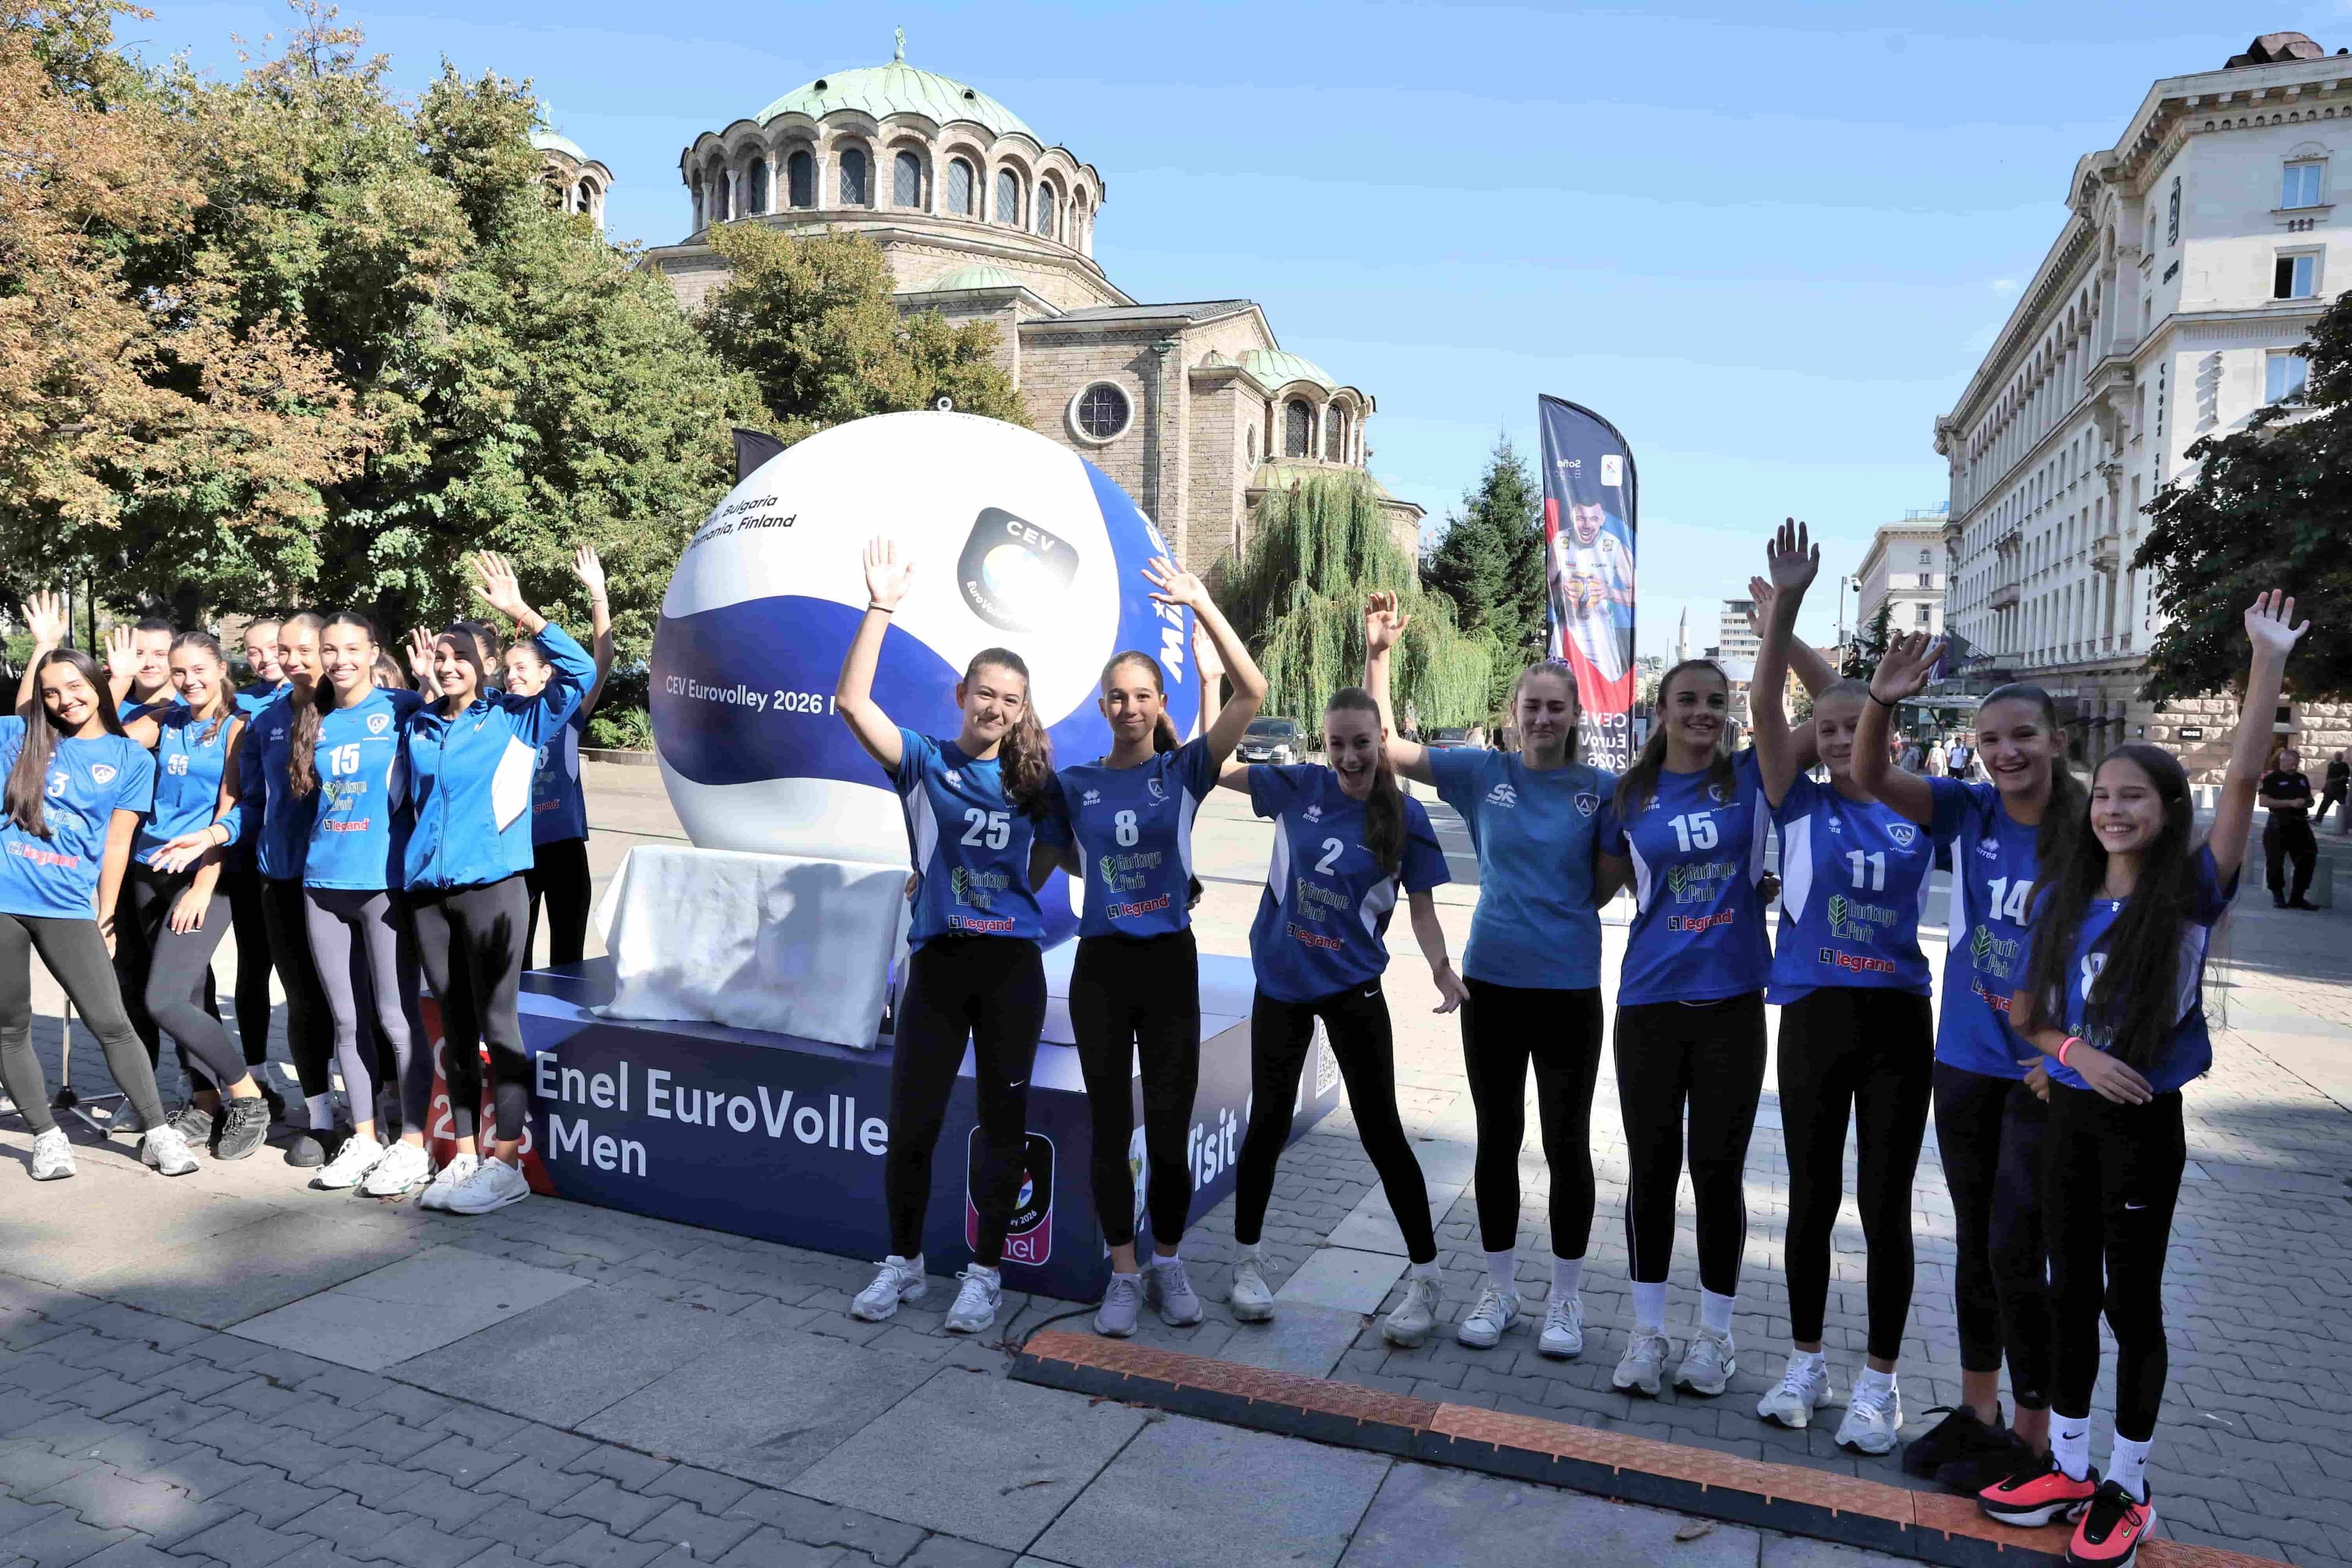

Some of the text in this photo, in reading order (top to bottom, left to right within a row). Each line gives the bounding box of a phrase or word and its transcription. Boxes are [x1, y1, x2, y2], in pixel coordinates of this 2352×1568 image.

[722, 494, 778, 518] Bulgaria
[737, 514, 797, 531] Finland
[1006, 520, 1055, 551] CEV
[666, 675, 687, 696] CEV
[688, 679, 768, 713] Eurovolley
[773, 690, 823, 715] 2026
[167, 753, 190, 776] 55
[329, 742, 361, 776] 15
[47, 771, 70, 797] 3
[960, 807, 1011, 850] 25
[1115, 809, 1139, 847] 8
[1667, 811, 1719, 853] 15
[1116, 851, 1162, 872] Garitage
[1314, 837, 1344, 876] 2
[1120, 872, 1145, 890] Park
[1686, 861, 1736, 881] Garitage
[1845, 850, 1886, 892] 11
[1305, 881, 1350, 911] Garitage
[1689, 883, 1716, 902] Park
[1987, 876, 2034, 926] 14
[1121, 894, 1170, 918] legrand
[1303, 900, 1327, 922] Park
[963, 916, 1013, 933] legrand
[1682, 908, 1733, 933] legrand
[1849, 921, 1874, 944] Park
[1295, 926, 1343, 951] legrand
[535, 1050, 628, 1112] Enel
[647, 1068, 889, 1156] EuroVolle
[549, 1114, 646, 1177] Men
[1019, 1210, 1038, 1224] 2026
[1005, 1236, 1035, 1261] nel
